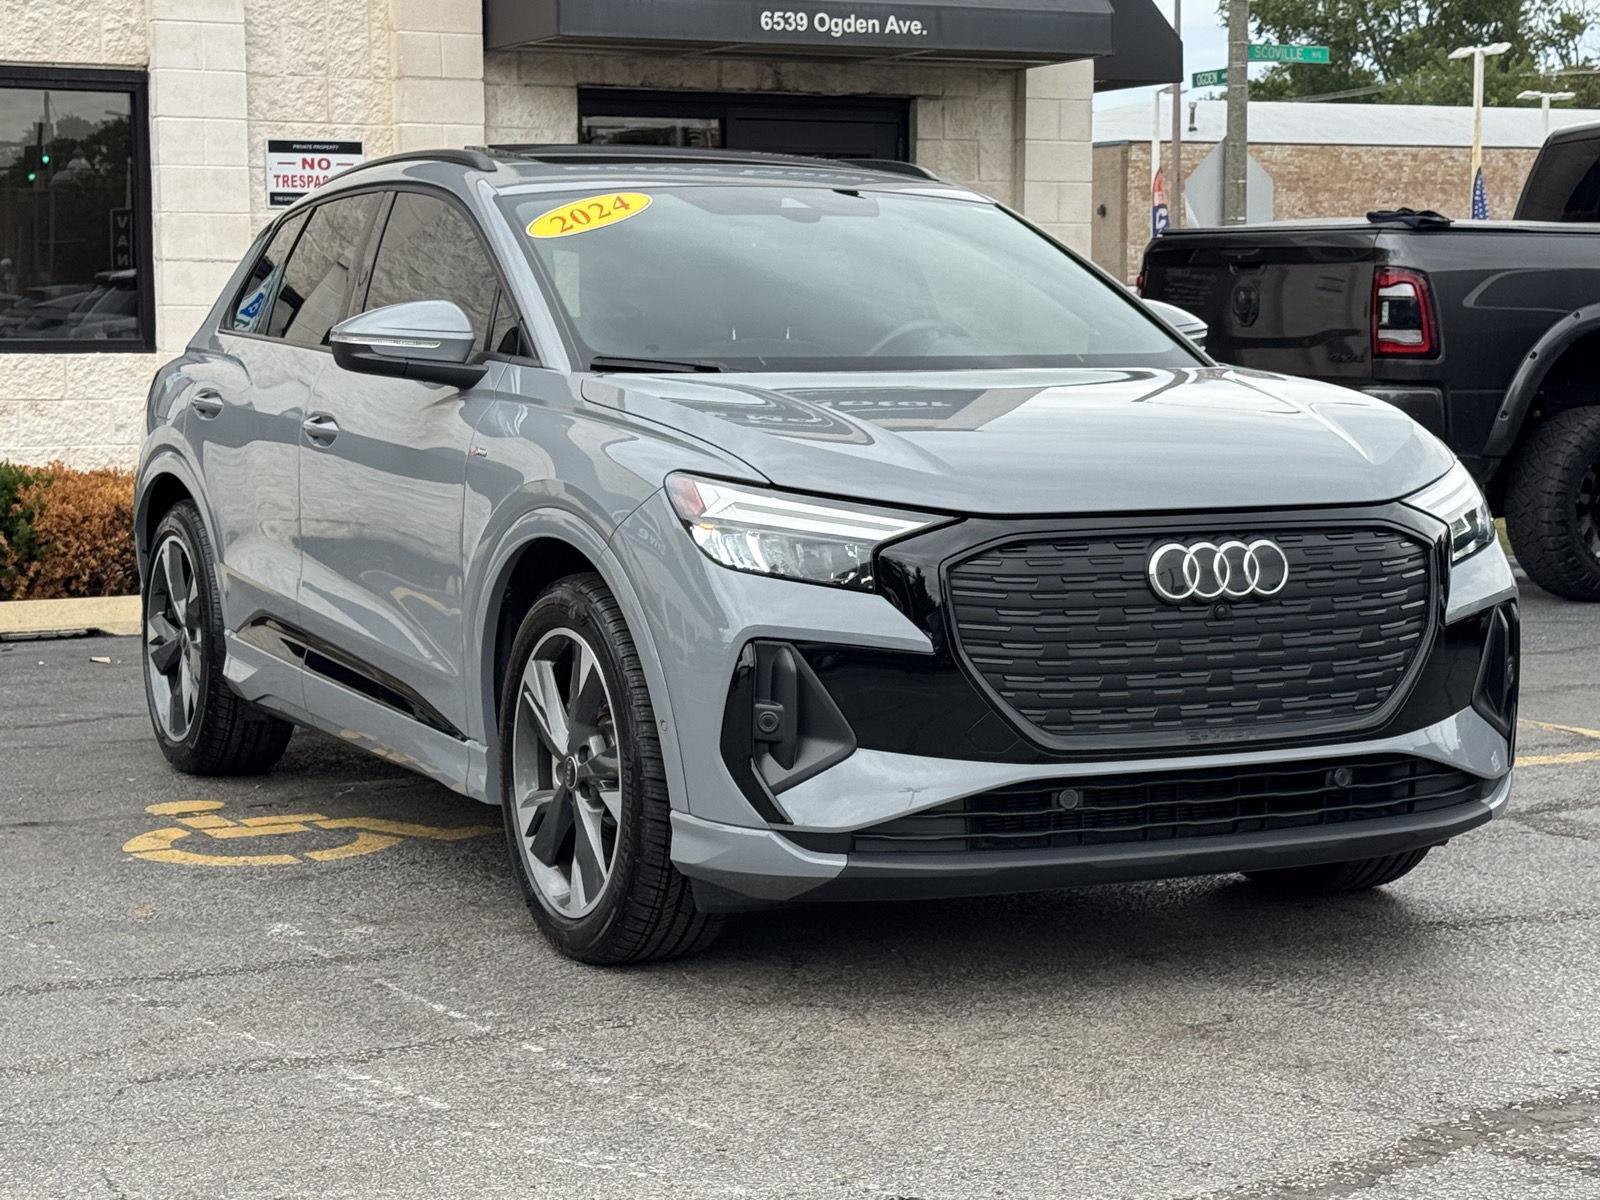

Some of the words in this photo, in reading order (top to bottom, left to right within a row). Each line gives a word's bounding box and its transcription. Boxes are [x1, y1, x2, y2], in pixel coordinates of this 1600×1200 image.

[760, 11, 808, 31] 6539
[813, 12, 880, 37] Ogden
[884, 15, 928, 35] Ave.
[1255, 46, 1304, 60] SCOVILLE
[1196, 72, 1218, 85] OGDEN
[302, 158, 331, 170] NO
[549, 196, 630, 233] 2024
